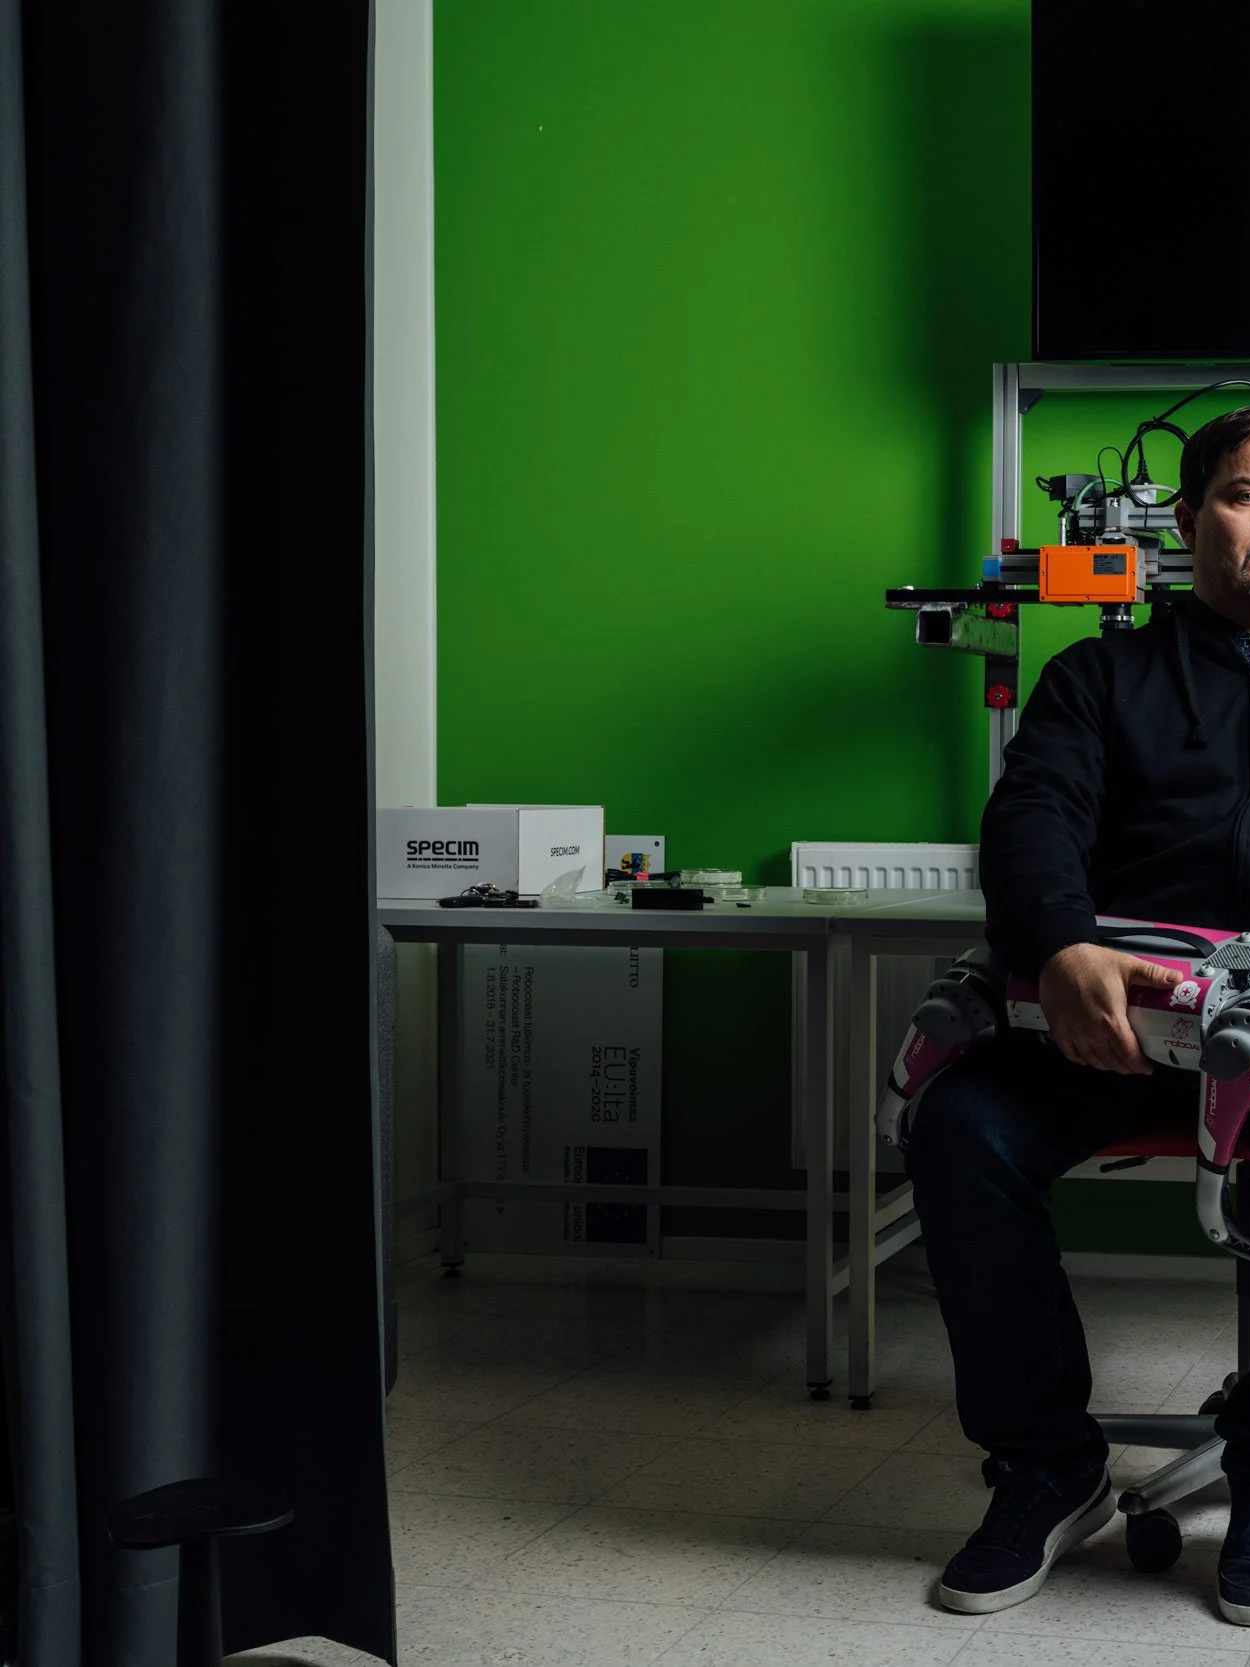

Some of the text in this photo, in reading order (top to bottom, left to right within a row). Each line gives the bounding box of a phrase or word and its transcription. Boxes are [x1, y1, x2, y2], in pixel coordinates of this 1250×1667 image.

[550, 846, 580, 857] SPECIM.COM
[499, 966, 509, 1024] Satakunnan
[511, 975, 521, 1028] Robocoast
[524, 966, 534, 1020] Robocoast
[511, 1030, 520, 1054] R&D
[511, 1055, 520, 1088] Center
[604, 1046, 626, 1124] EU:lta
[628, 1047, 640, 1123] Vipuvoimaa
